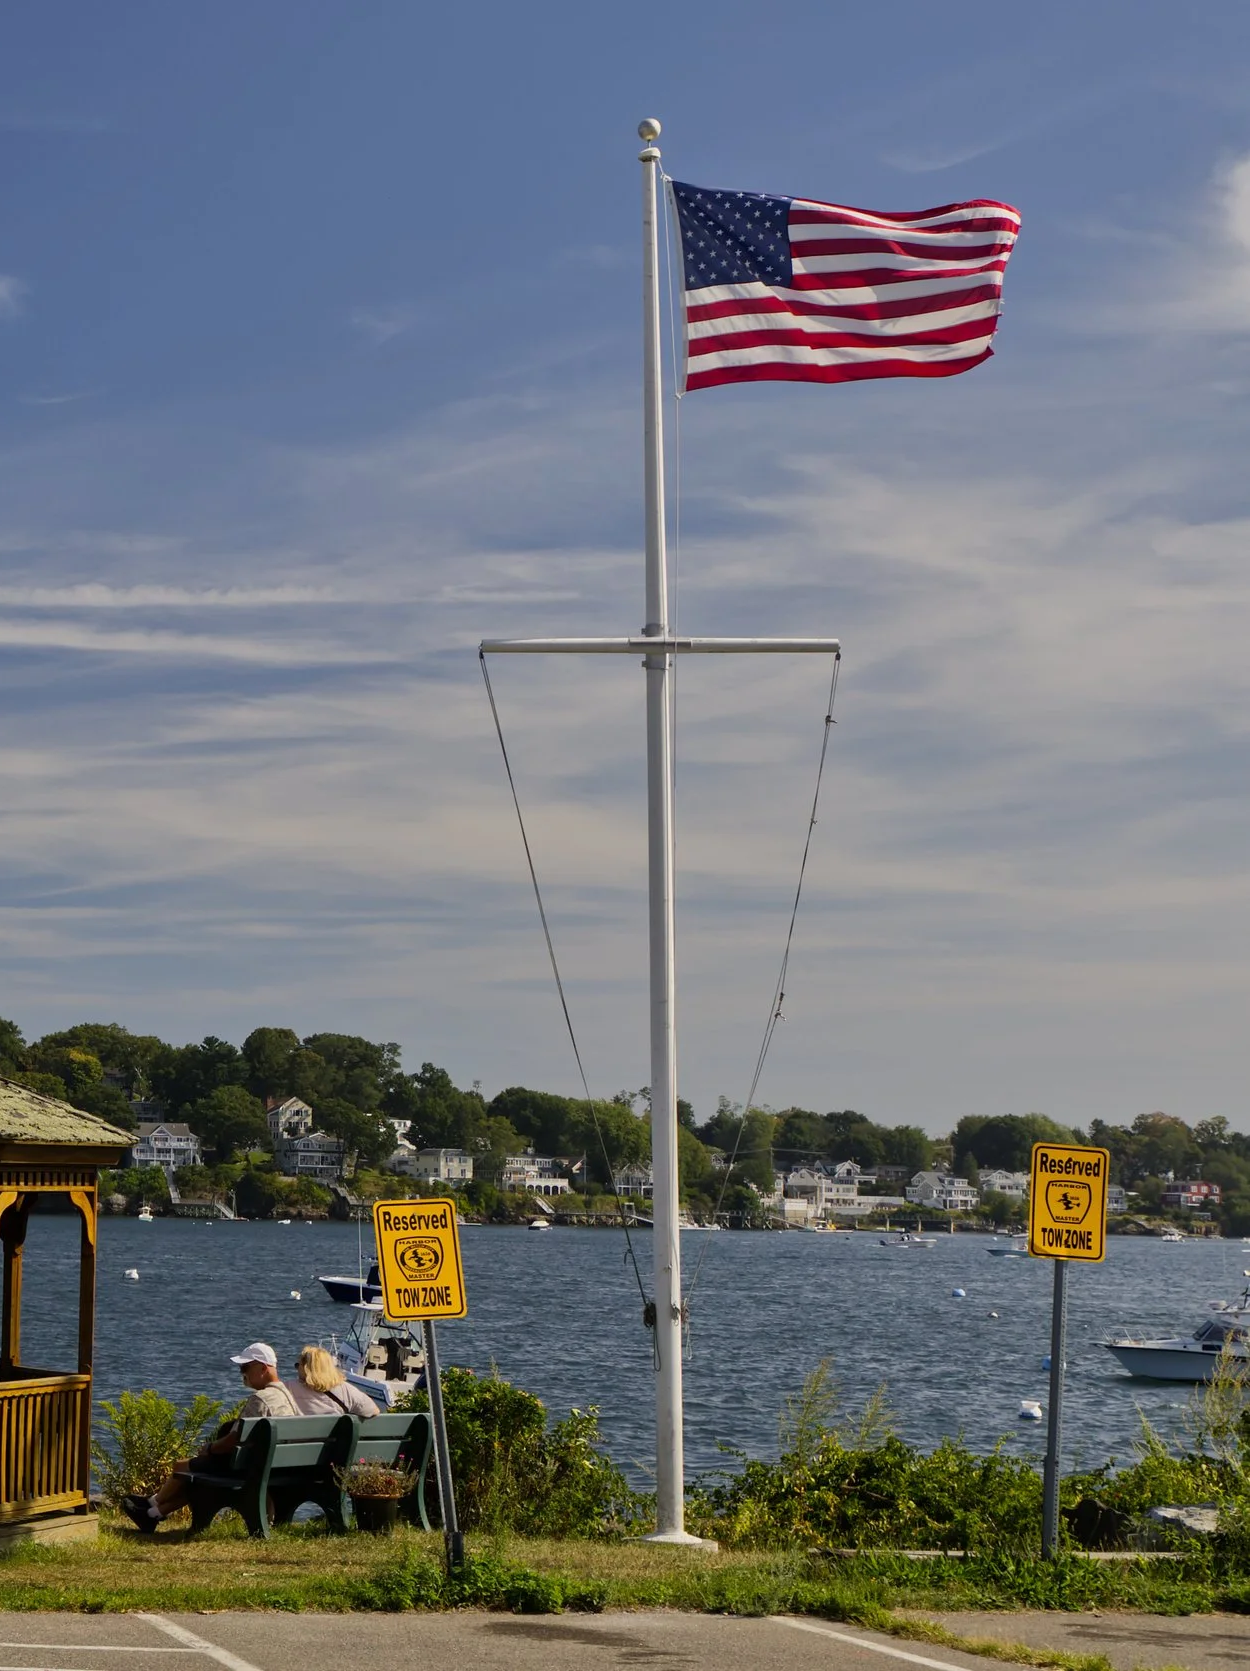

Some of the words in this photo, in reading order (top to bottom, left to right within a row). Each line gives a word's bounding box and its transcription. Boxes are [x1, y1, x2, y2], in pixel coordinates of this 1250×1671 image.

[1040, 1153, 1101, 1177] Reserved
[382, 1208, 448, 1231] Reserved
[1041, 1227, 1064, 1248] TOW
[1064, 1229, 1092, 1250] ZONE
[395, 1287, 420, 1308] TOW
[421, 1286, 453, 1308] ZONE
